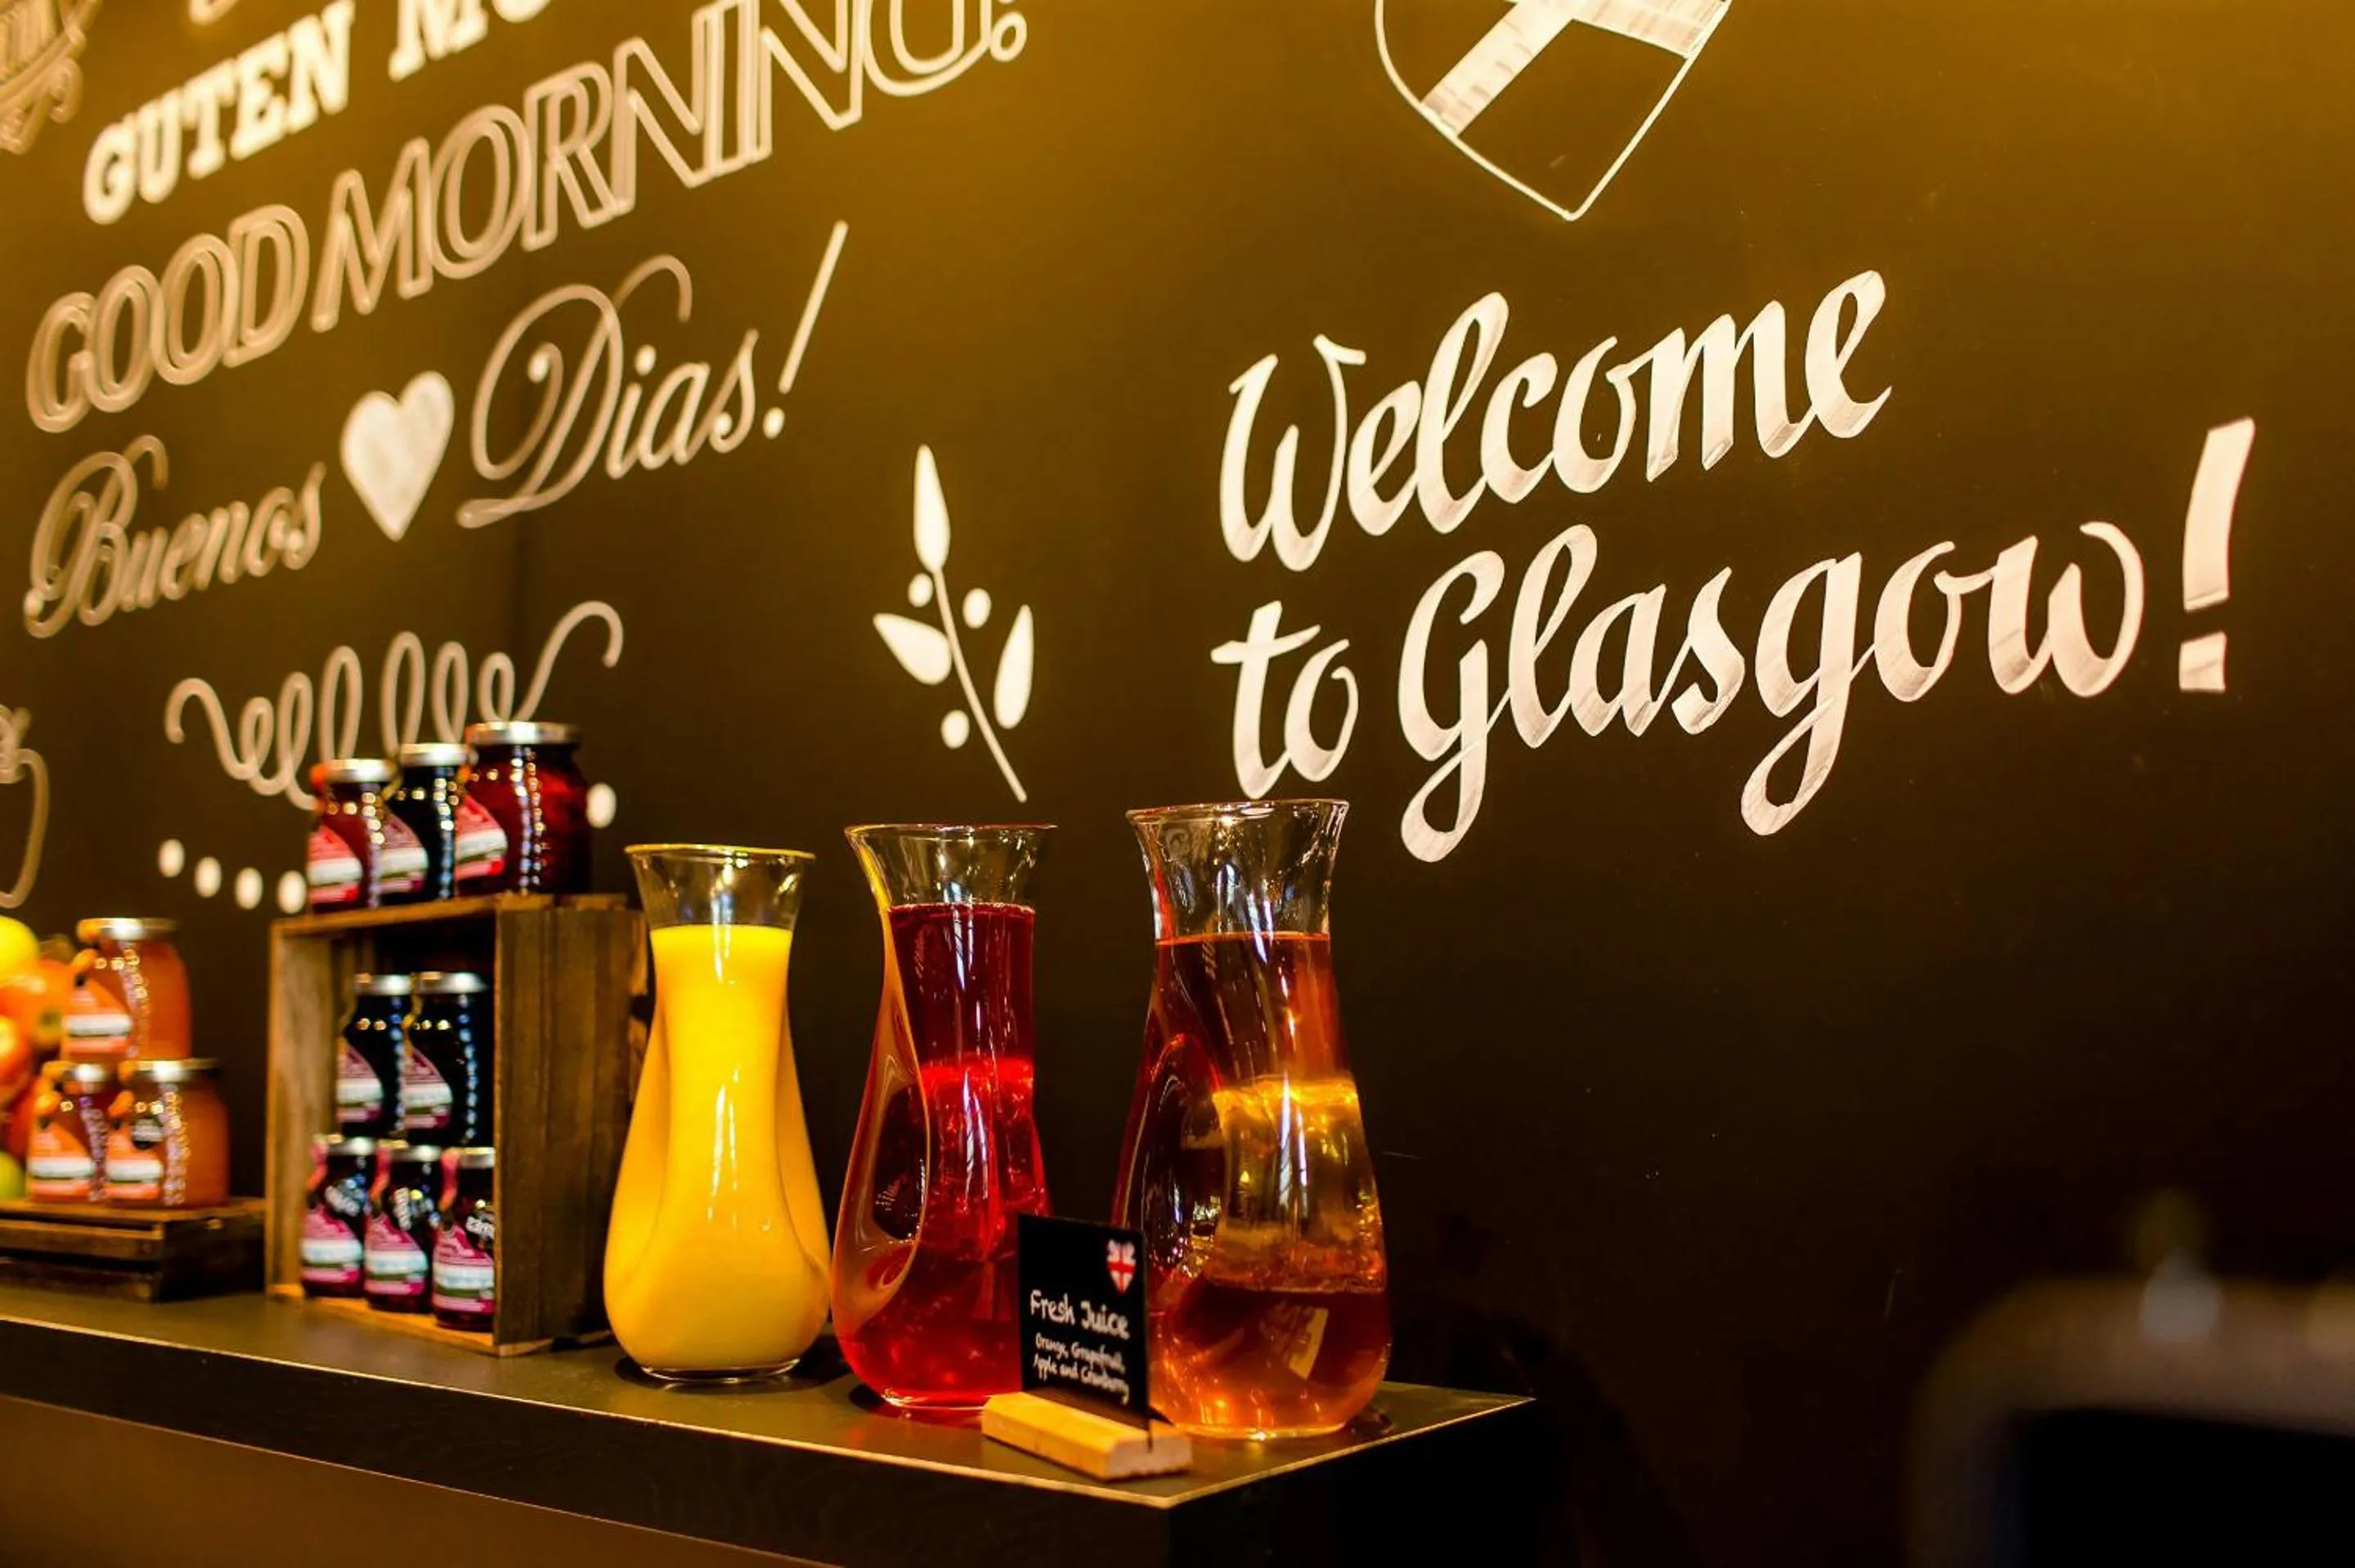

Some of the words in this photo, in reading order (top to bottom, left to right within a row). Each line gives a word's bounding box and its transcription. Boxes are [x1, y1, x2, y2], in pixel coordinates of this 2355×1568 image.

[25, 204, 310, 434] GOOD
[311, 0, 1028, 333] MORNING
[83, 0, 356, 225] GUTEN
[1219, 270, 1892, 572] Welcome
[23, 435, 326, 639] Buenos
[1210, 600, 1359, 800] to
[1397, 416, 2256, 863] Glasgow!
[1030, 1288, 1076, 1326] Fresh
[1079, 1300, 1130, 1341] Juice
[1059, 1360, 1079, 1380] and
